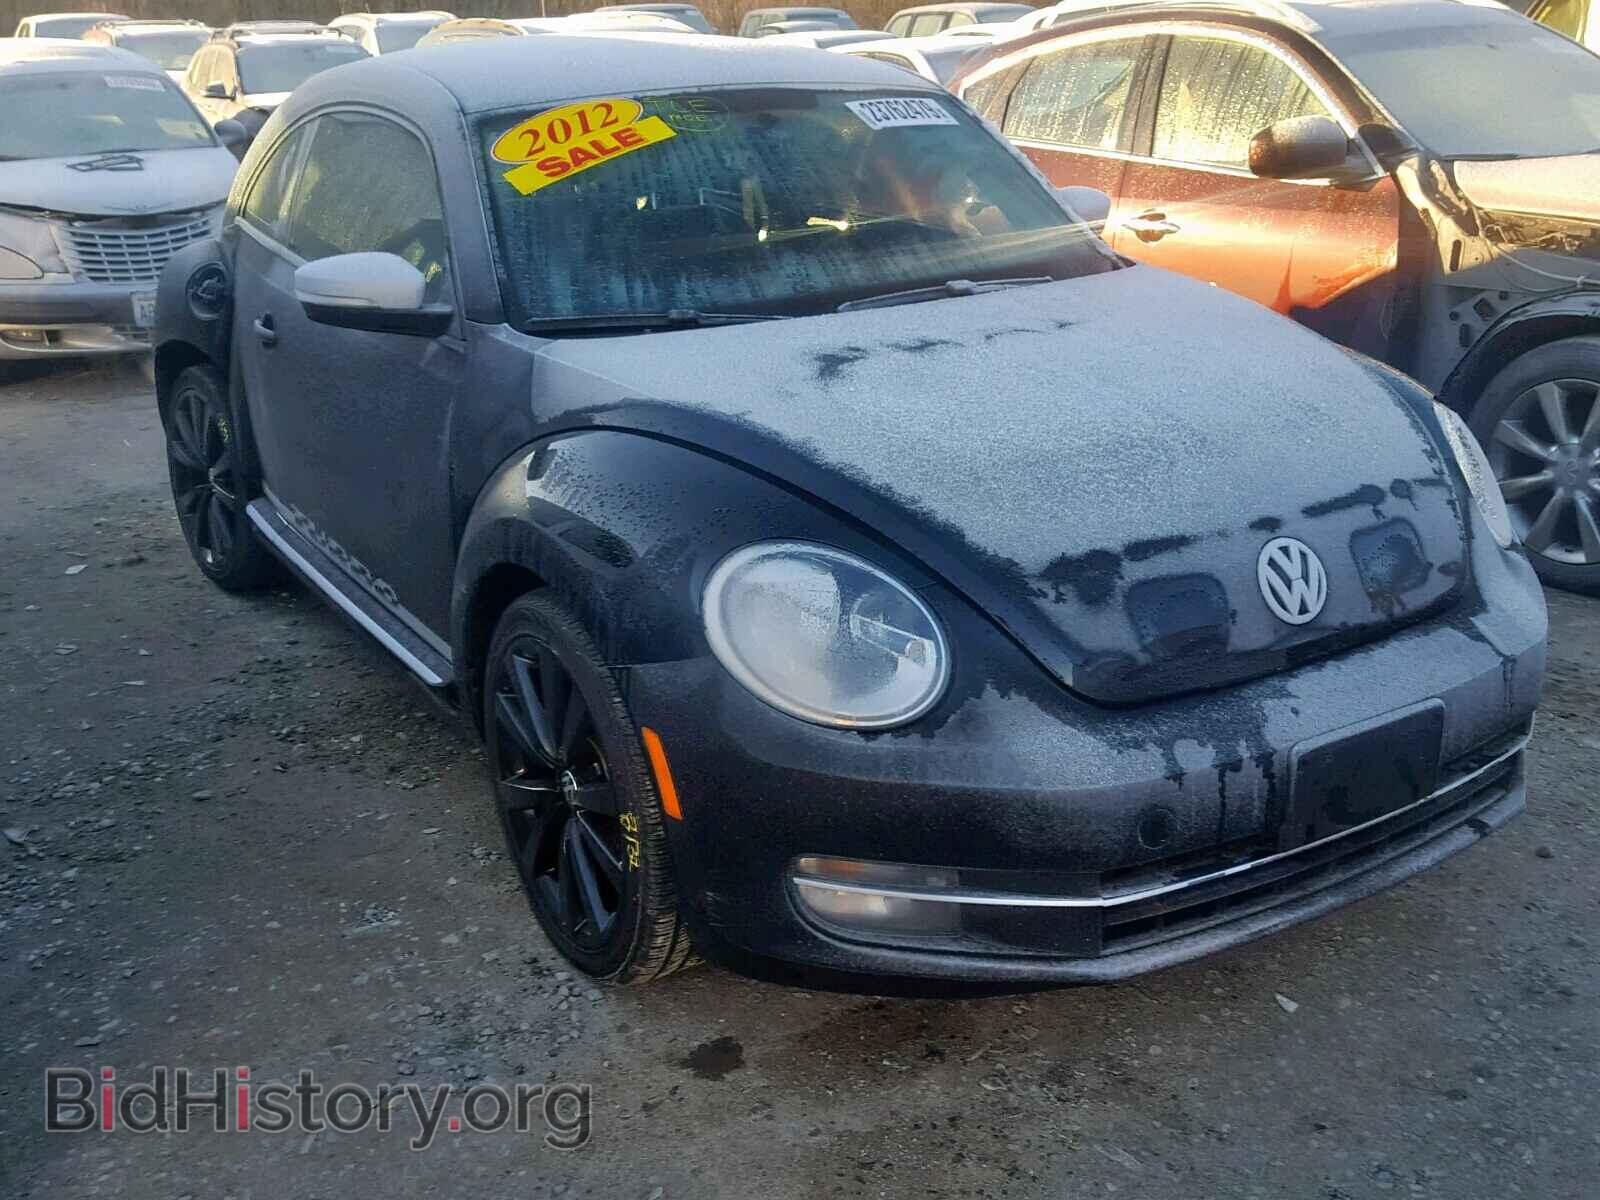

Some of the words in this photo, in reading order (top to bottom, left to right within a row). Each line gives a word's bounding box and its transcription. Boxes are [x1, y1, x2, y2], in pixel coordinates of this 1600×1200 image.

[518, 102, 618, 158] 2012
[536, 127, 645, 177] SALE
[1258, 537, 1327, 624] VW
